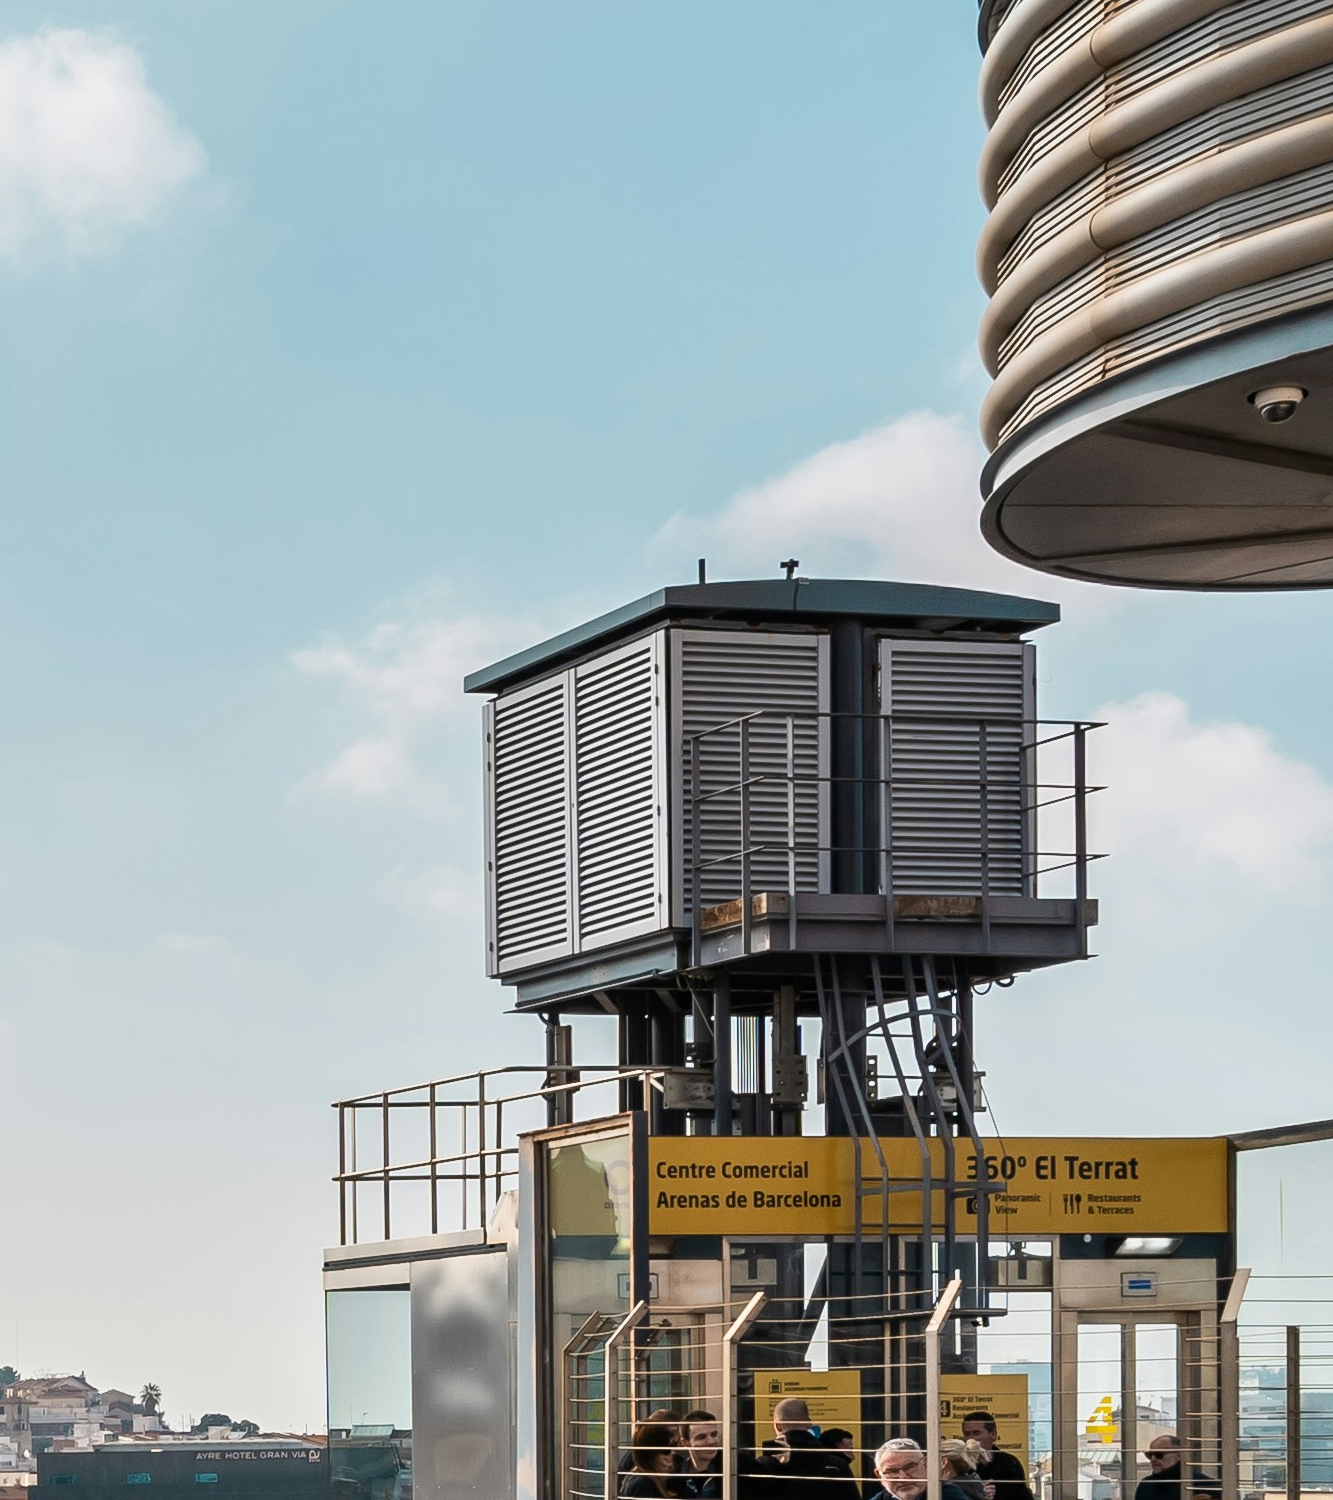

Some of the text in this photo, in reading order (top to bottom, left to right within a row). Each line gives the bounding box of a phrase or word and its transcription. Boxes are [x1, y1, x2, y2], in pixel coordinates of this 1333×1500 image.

[656, 1161, 809, 1179] Centre Comercial
[1035, 1156, 1056, 1179] El
[1064, 1156, 1139, 1180] Terrat
[656, 1191, 842, 1208] Arenas de Barcelona
[994, 1193, 1041, 1203] Panoramic
[1087, 1193, 1141, 1203] Restaurants
[995, 1205, 1018, 1215] View
[1088, 1205, 1134, 1215] & Terraces
[196, 1451, 307, 1460] AYRE HOTEL GRAN VIA
